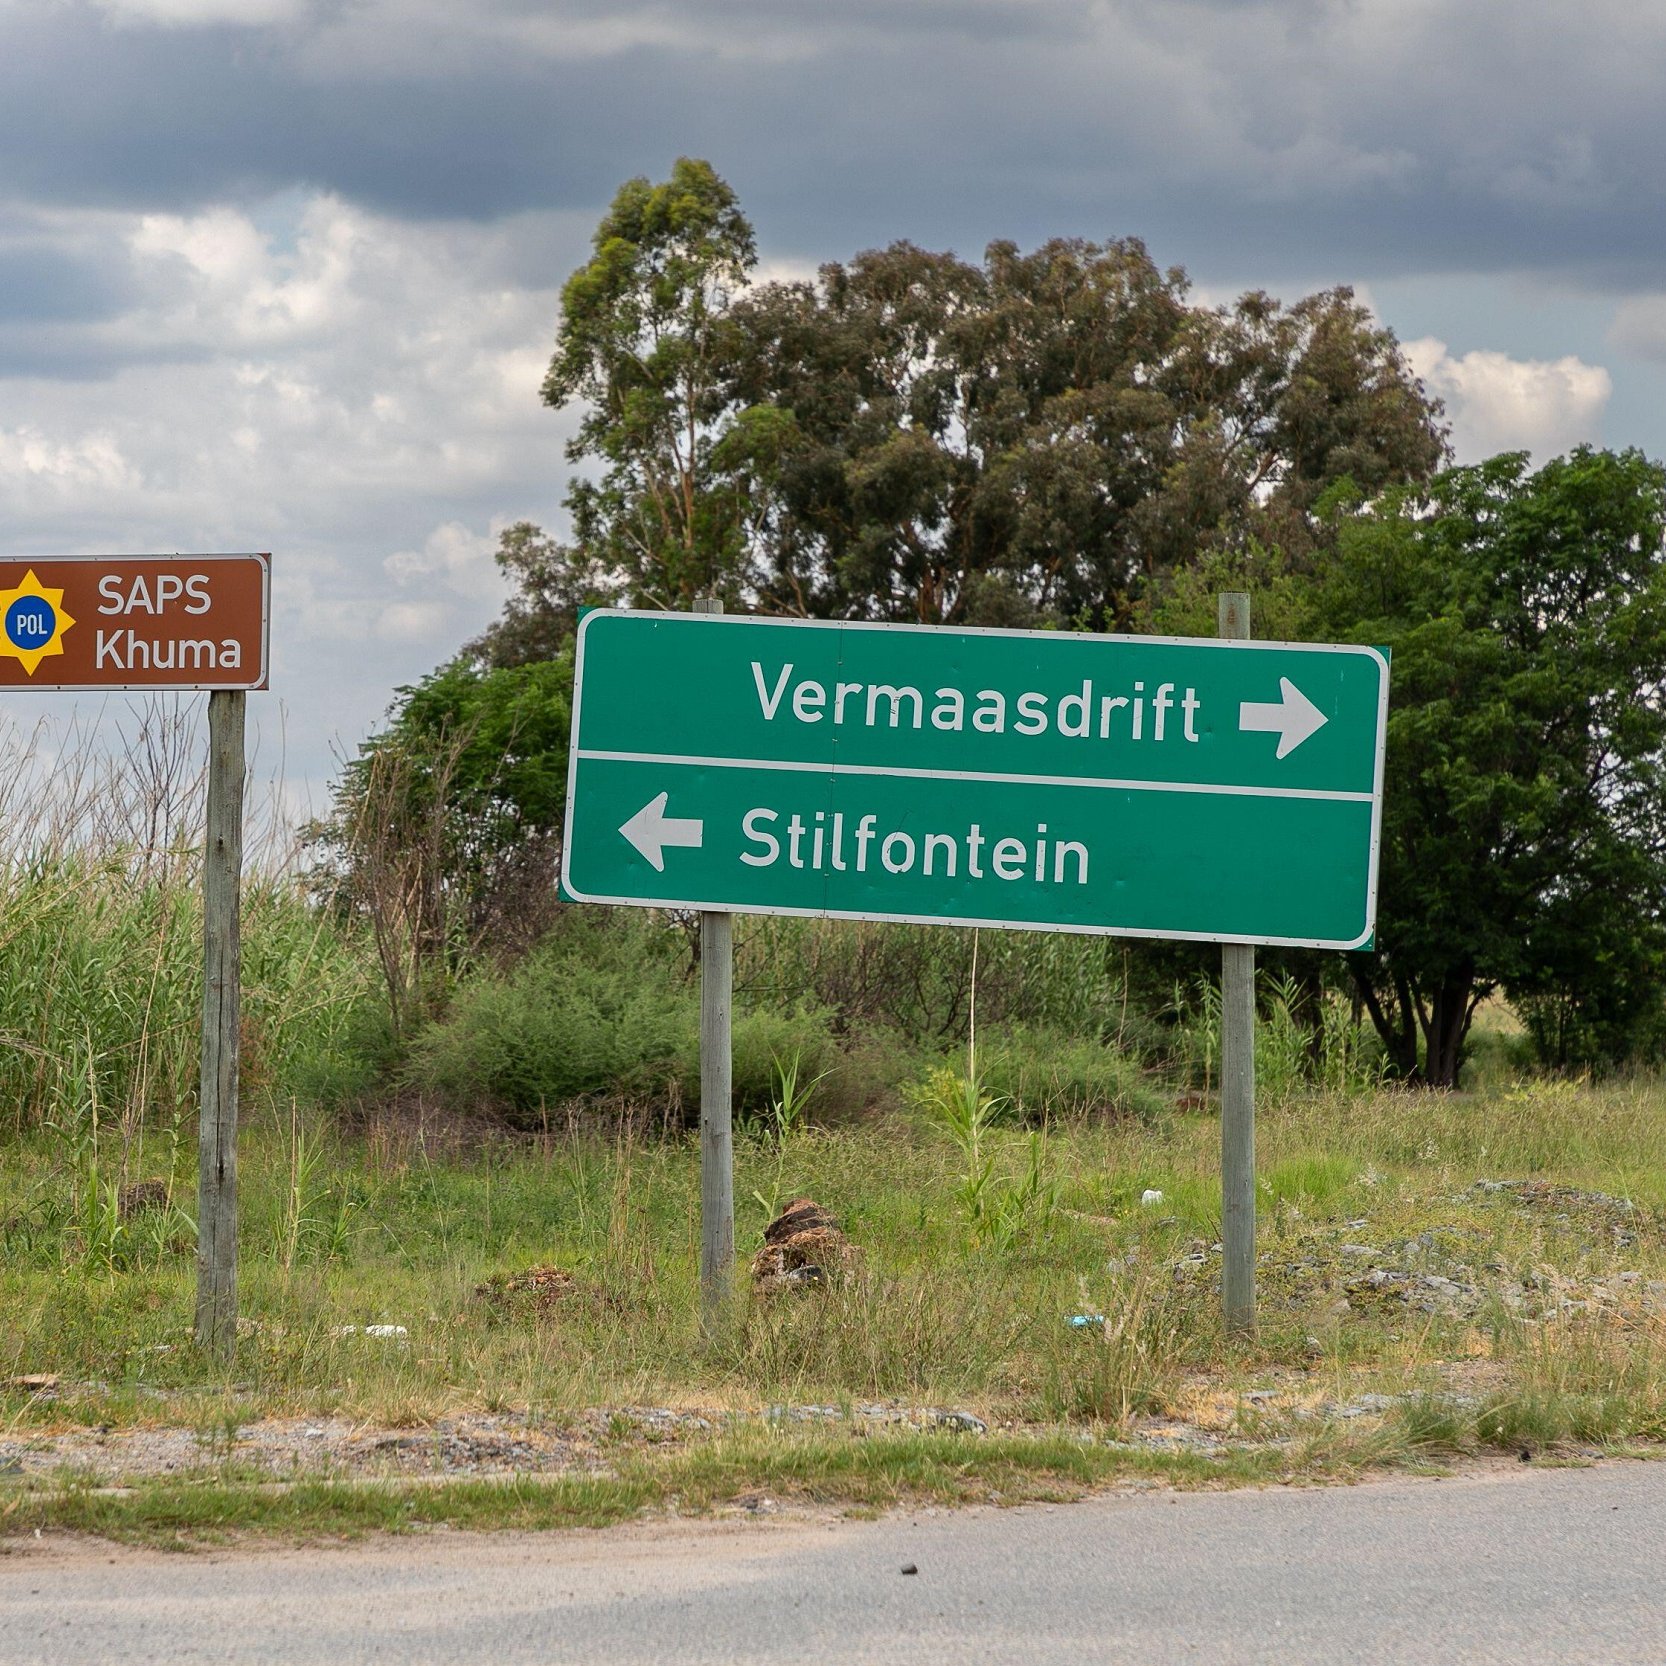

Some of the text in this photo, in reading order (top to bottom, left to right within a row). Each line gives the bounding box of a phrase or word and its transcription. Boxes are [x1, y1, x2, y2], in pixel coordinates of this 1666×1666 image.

[97, 574, 212, 615] SAPS
[16, 614, 48, 636] POL
[96, 629, 241, 669] Khuma
[751, 661, 1201, 743] Vermaasdrift
[739, 807, 1089, 884] Stilfontein
